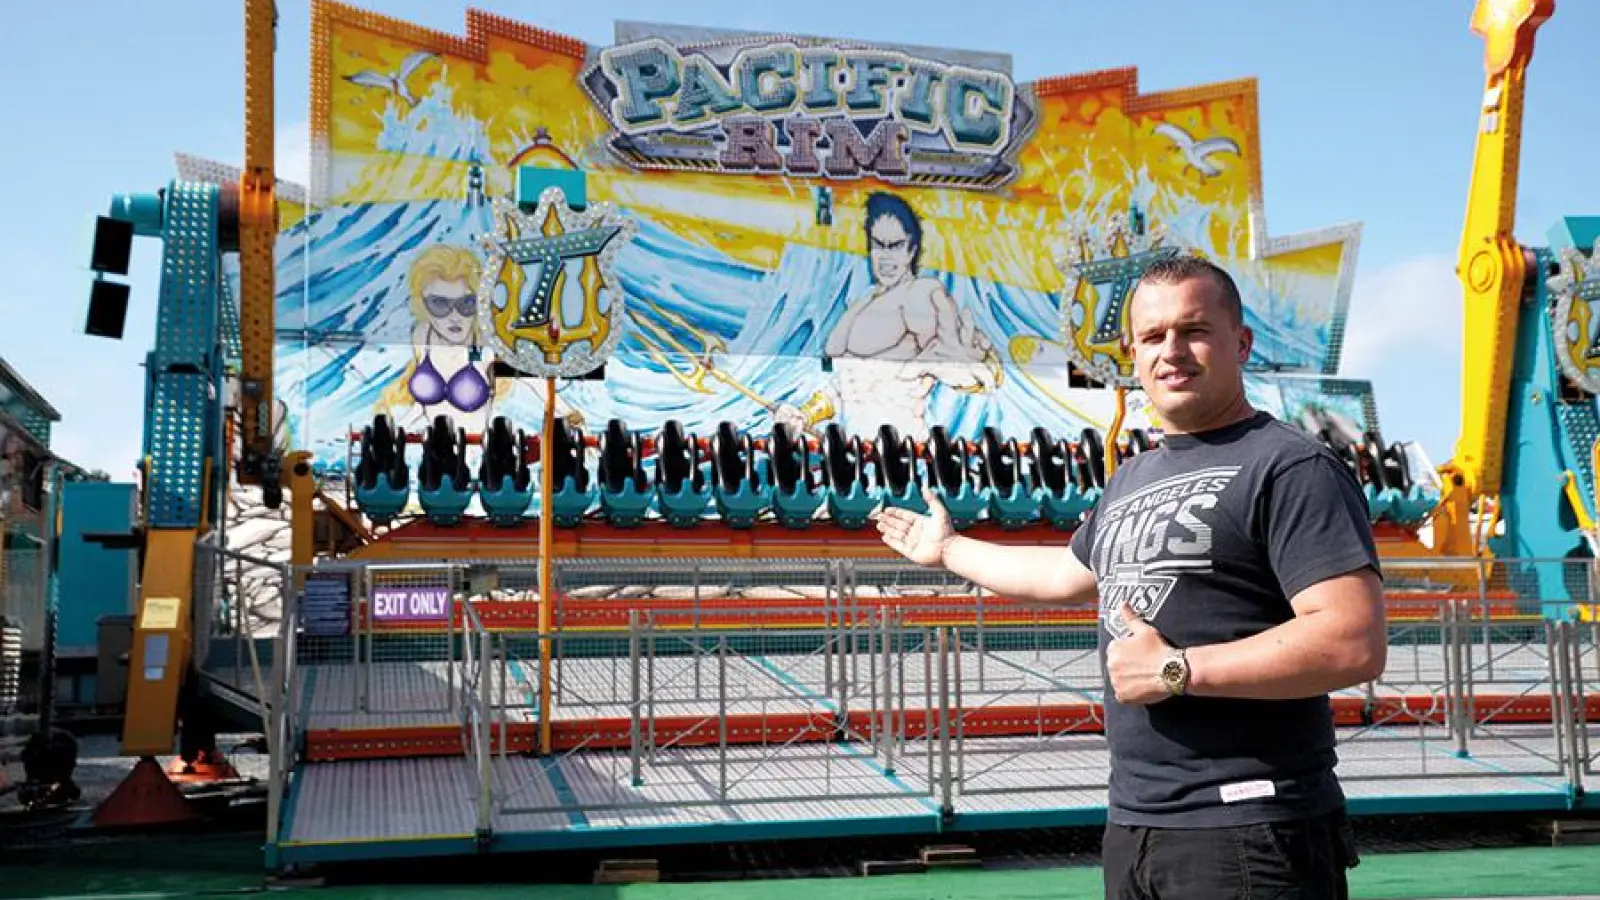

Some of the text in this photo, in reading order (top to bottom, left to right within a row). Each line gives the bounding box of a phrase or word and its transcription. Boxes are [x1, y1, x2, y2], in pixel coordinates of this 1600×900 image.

[609, 40, 1011, 147] PACIFIC
[720, 116, 911, 177] RIM
[1126, 477, 1232, 516] ANGELES
[374, 591, 407, 616] EXIT
[410, 590, 448, 616] ONLY
